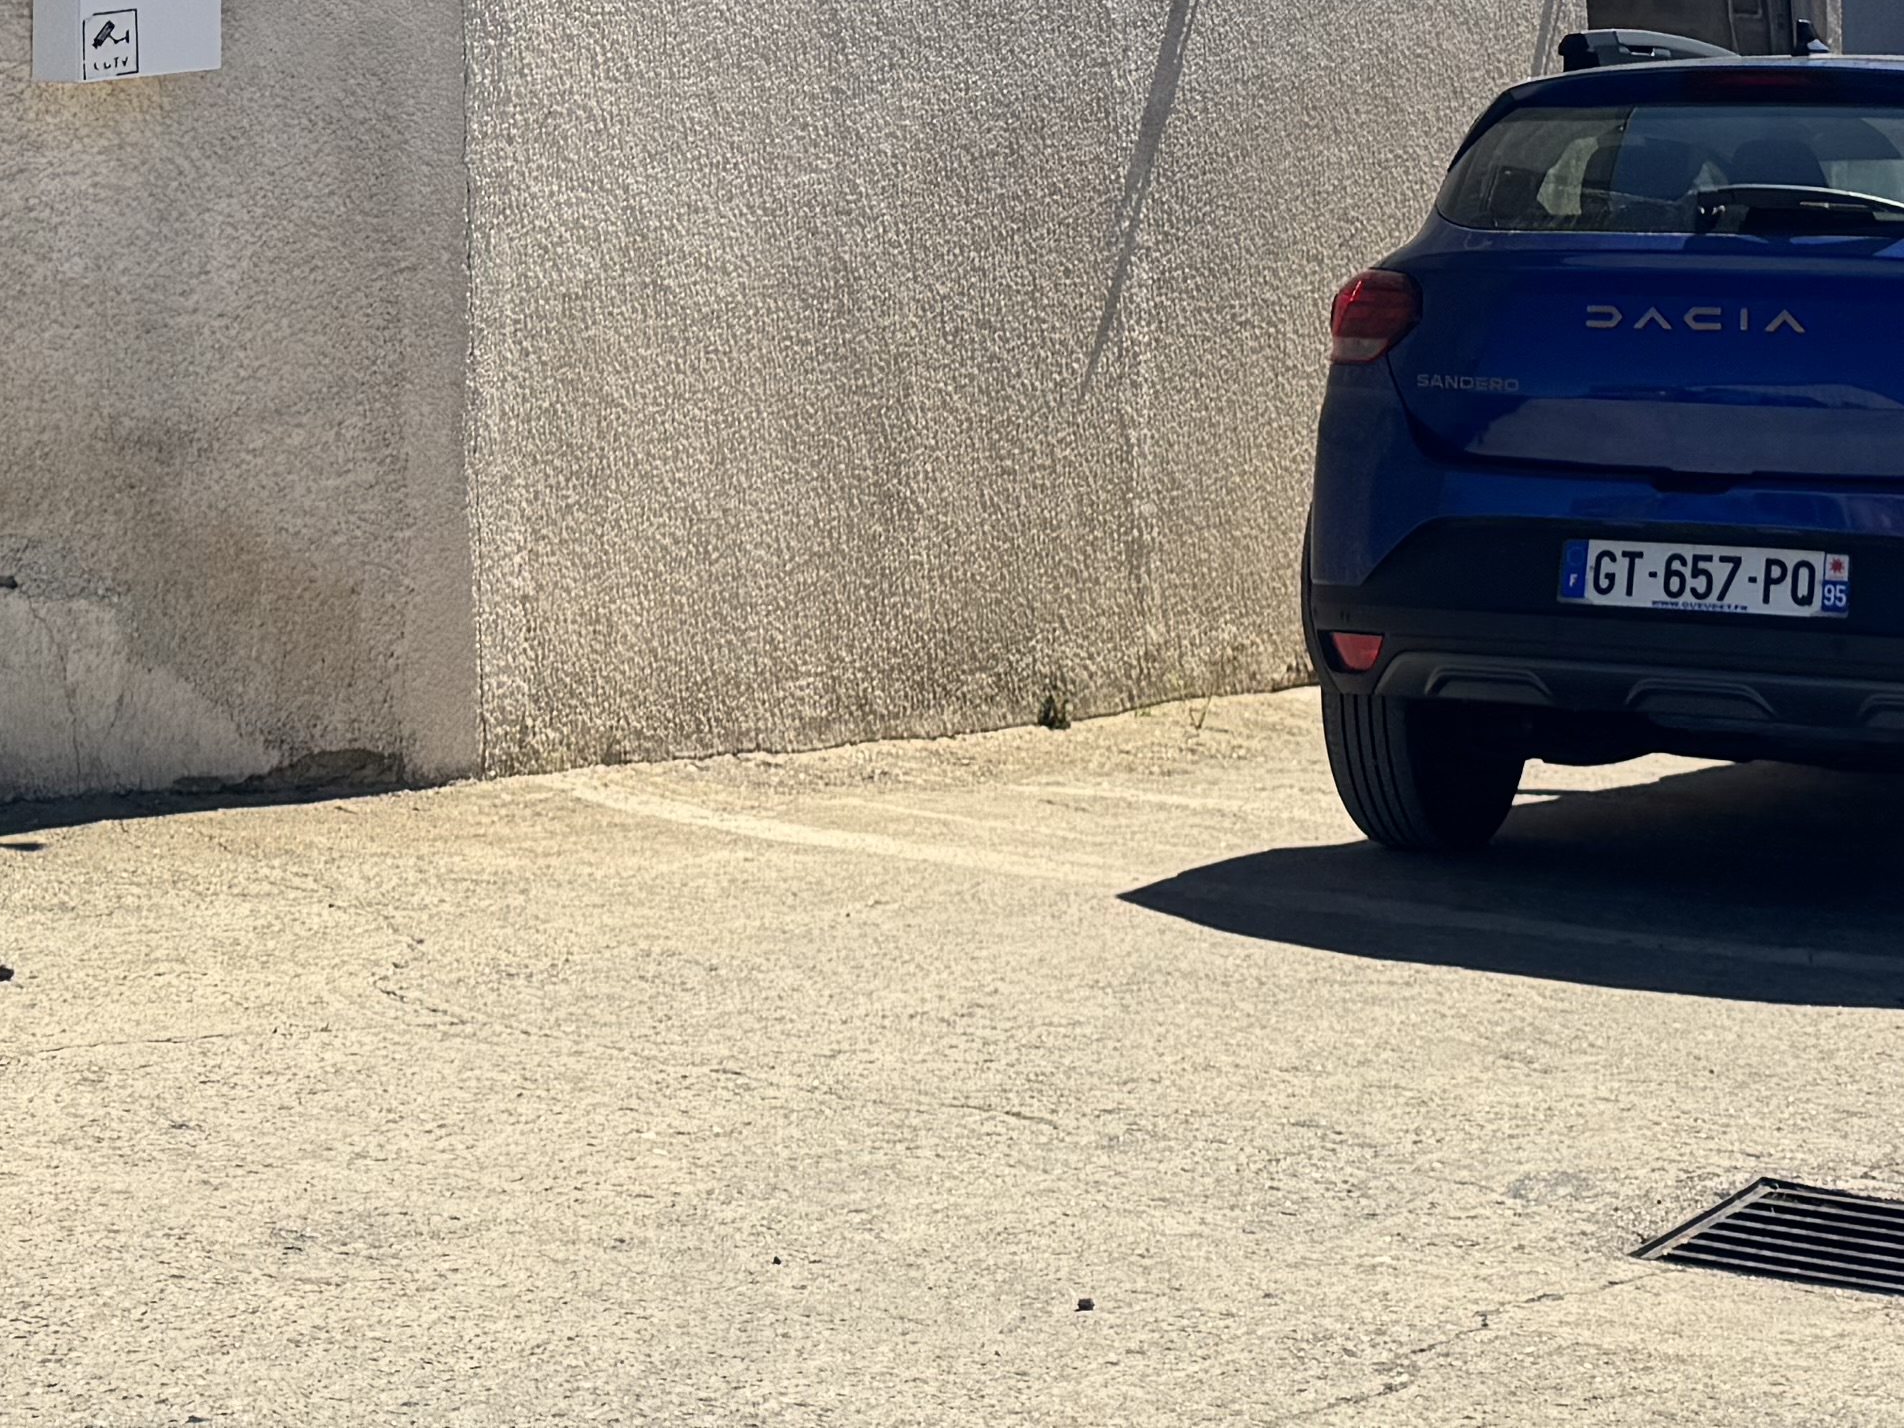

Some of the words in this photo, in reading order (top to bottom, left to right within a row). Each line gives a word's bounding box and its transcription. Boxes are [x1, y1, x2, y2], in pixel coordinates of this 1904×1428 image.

[1585, 305, 1806, 334] DACIA
[1416, 373, 1520, 392] SANDERO
[1592, 549, 1817, 607] GT-657-PQ
[1823, 584, 1847, 607] 95
